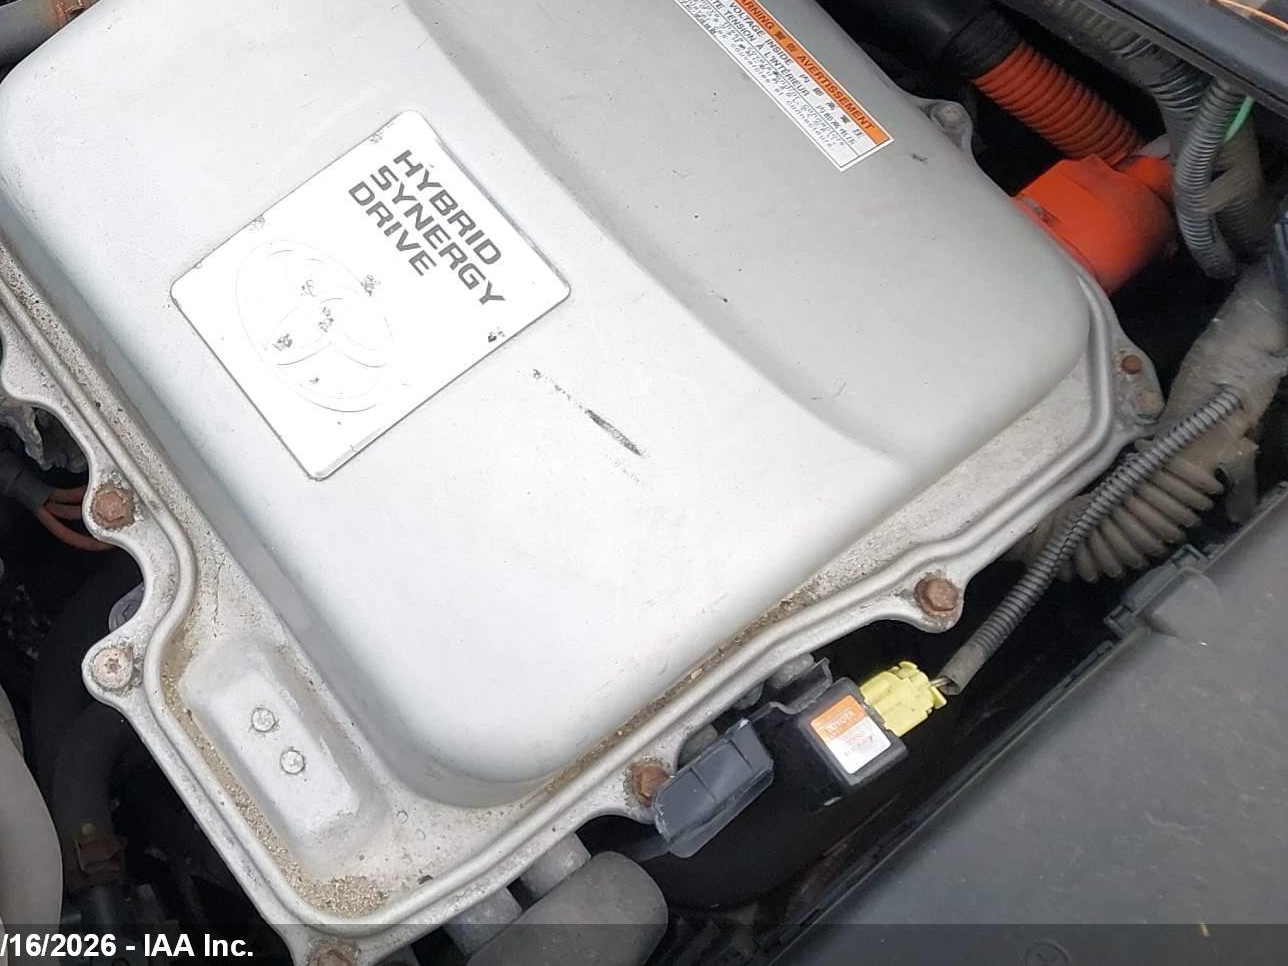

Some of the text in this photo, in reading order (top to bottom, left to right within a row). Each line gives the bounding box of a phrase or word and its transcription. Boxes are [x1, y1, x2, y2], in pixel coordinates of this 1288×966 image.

[722, 10, 757, 42] TENSION
[727, 2, 765, 37] VOLTAGE
[763, 38, 794, 66] INSIDE
[794, 53, 876, 131] AVERTISSEMENT
[349, 181, 437, 276] DRIVE
[371, 165, 505, 305] SYNERGY
[394, 150, 502, 265] HYBRID
